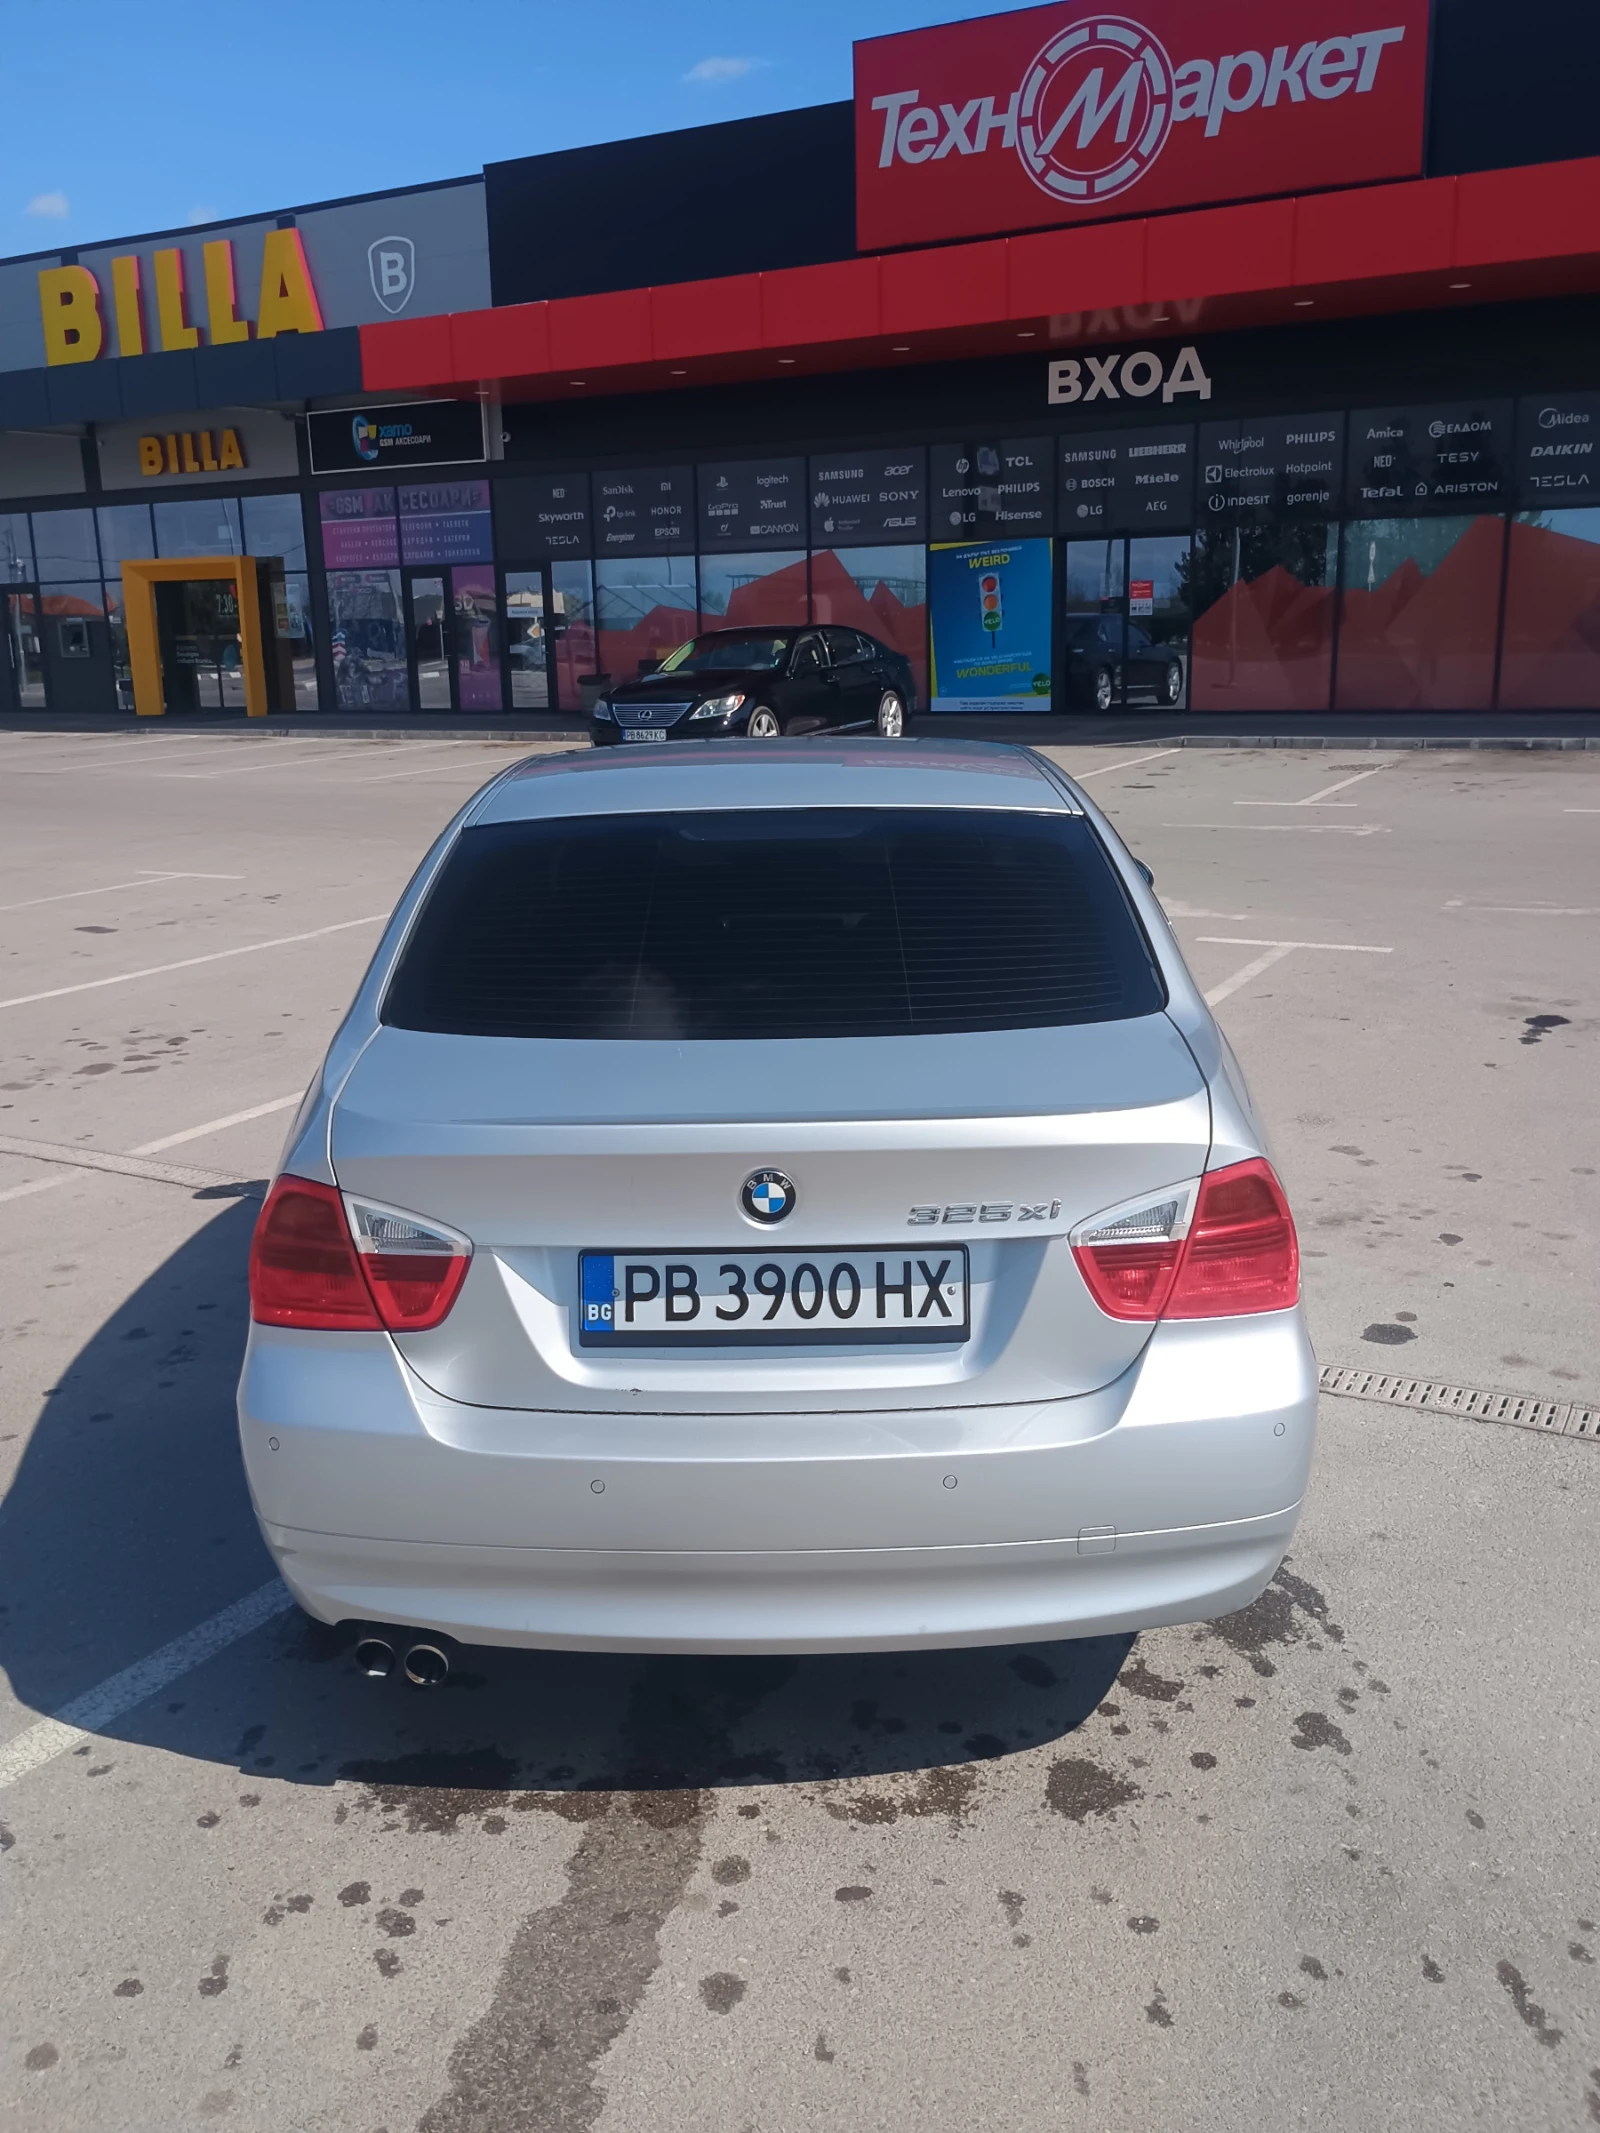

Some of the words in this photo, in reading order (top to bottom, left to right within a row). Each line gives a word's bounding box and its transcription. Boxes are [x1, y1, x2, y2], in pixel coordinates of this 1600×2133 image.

[38, 227, 325, 366] BILLA
[1047, 346, 1212, 404] ВХОД
[1548, 412, 1590, 426] Midea
[1285, 430, 1336, 445] PHILIPS
[1366, 426, 1404, 440] Amica
[1128, 443, 1187, 458] LIEBHERR
[1218, 437, 1265, 454] Whirlpool
[1530, 443, 1594, 457] DAIKIN
[139, 428, 247, 477] BILLA
[1064, 449, 1117, 463] SAMSUNG
[1437, 451, 1480, 463] TESY
[1005, 455, 1033, 468] TCL
[1285, 460, 1333, 475] Hotpoint
[1373, 454, 1393, 469] NEO
[818, 468, 864, 481] SAMSUNG
[884, 464, 914, 477] acer
[1224, 465, 1275, 479] Electrolux
[756, 474, 789, 488] logitech
[1080, 477, 1116, 489] BOSCH
[1134, 472, 1180, 485] Miele
[1530, 474, 1590, 487] TESLA
[602, 484, 635, 496] SanDisk
[942, 486, 981, 498] Lenovo
[997, 481, 1041, 495] PHILIPS
[1360, 486, 1404, 499] Tefal
[1434, 482, 1499, 494] ARISTON
[832, 493, 871, 506] HUAWEI
[879, 490, 920, 502] SONY
[1286, 490, 1330, 505] gorenje
[651, 505, 682, 516] HONOR
[767, 499, 787, 510] Trust
[1089, 504, 1103, 516] LG
[1145, 500, 1168, 512] AEG
[538, 511, 584, 524] Skyworth
[883, 516, 917, 528] ASUS
[962, 511, 976, 523] LG
[995, 509, 1042, 522] Hisense
[654, 526, 680, 538] EPSON
[760, 523, 799, 535] CANYON
[605, 532, 636, 544] Energizer
[968, 554, 1011, 569] WEIRD
[956, 661, 1033, 679] WONDERFUL
[907, 1198, 1063, 1227] 325xi
[624, 1263, 701, 1324] PB
[715, 1262, 862, 1322] 3900
[875, 1259, 953, 1320] HX
[586, 1303, 613, 1322] BG
